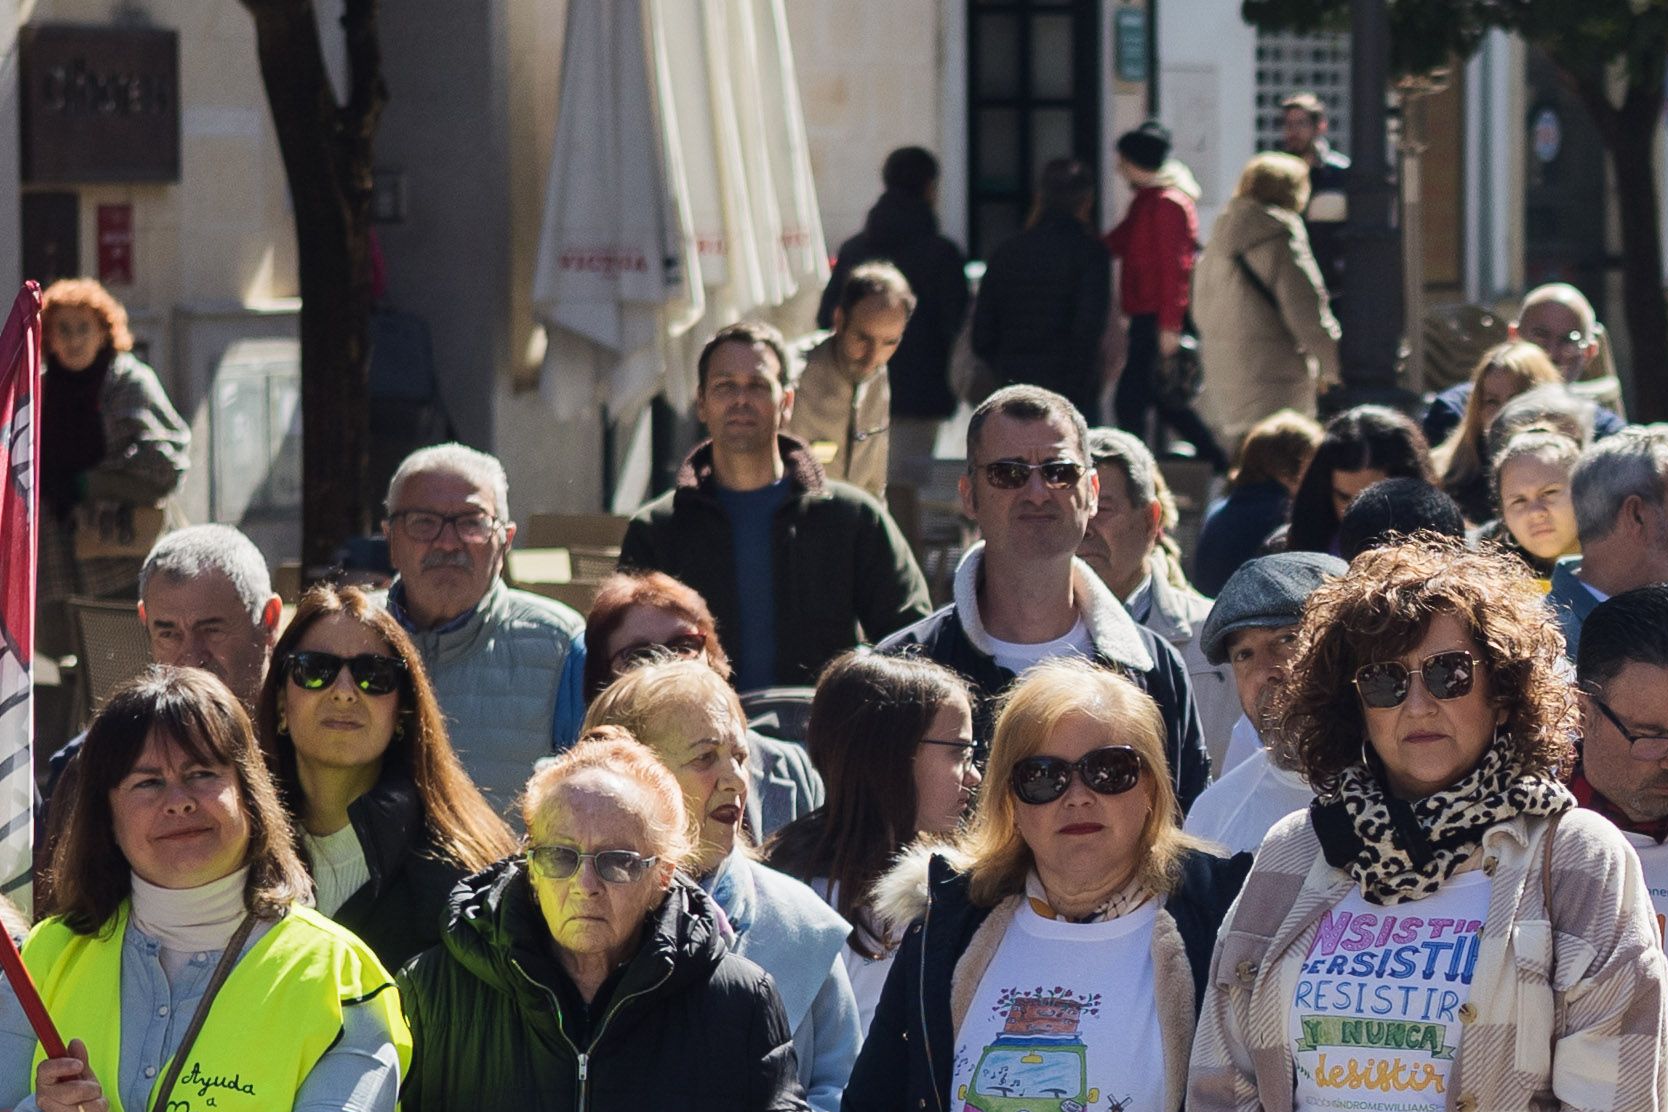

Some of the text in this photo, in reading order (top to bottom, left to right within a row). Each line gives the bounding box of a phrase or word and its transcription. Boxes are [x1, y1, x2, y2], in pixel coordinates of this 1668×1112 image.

[1294, 980, 1459, 1023] RESISTIR
[1304, 1019, 1438, 1050] Y NUNCA
[181, 1062, 256, 1096] Ayuda
[1314, 1053, 1446, 1094] desistir
[206, 1097, 217, 1107] a
